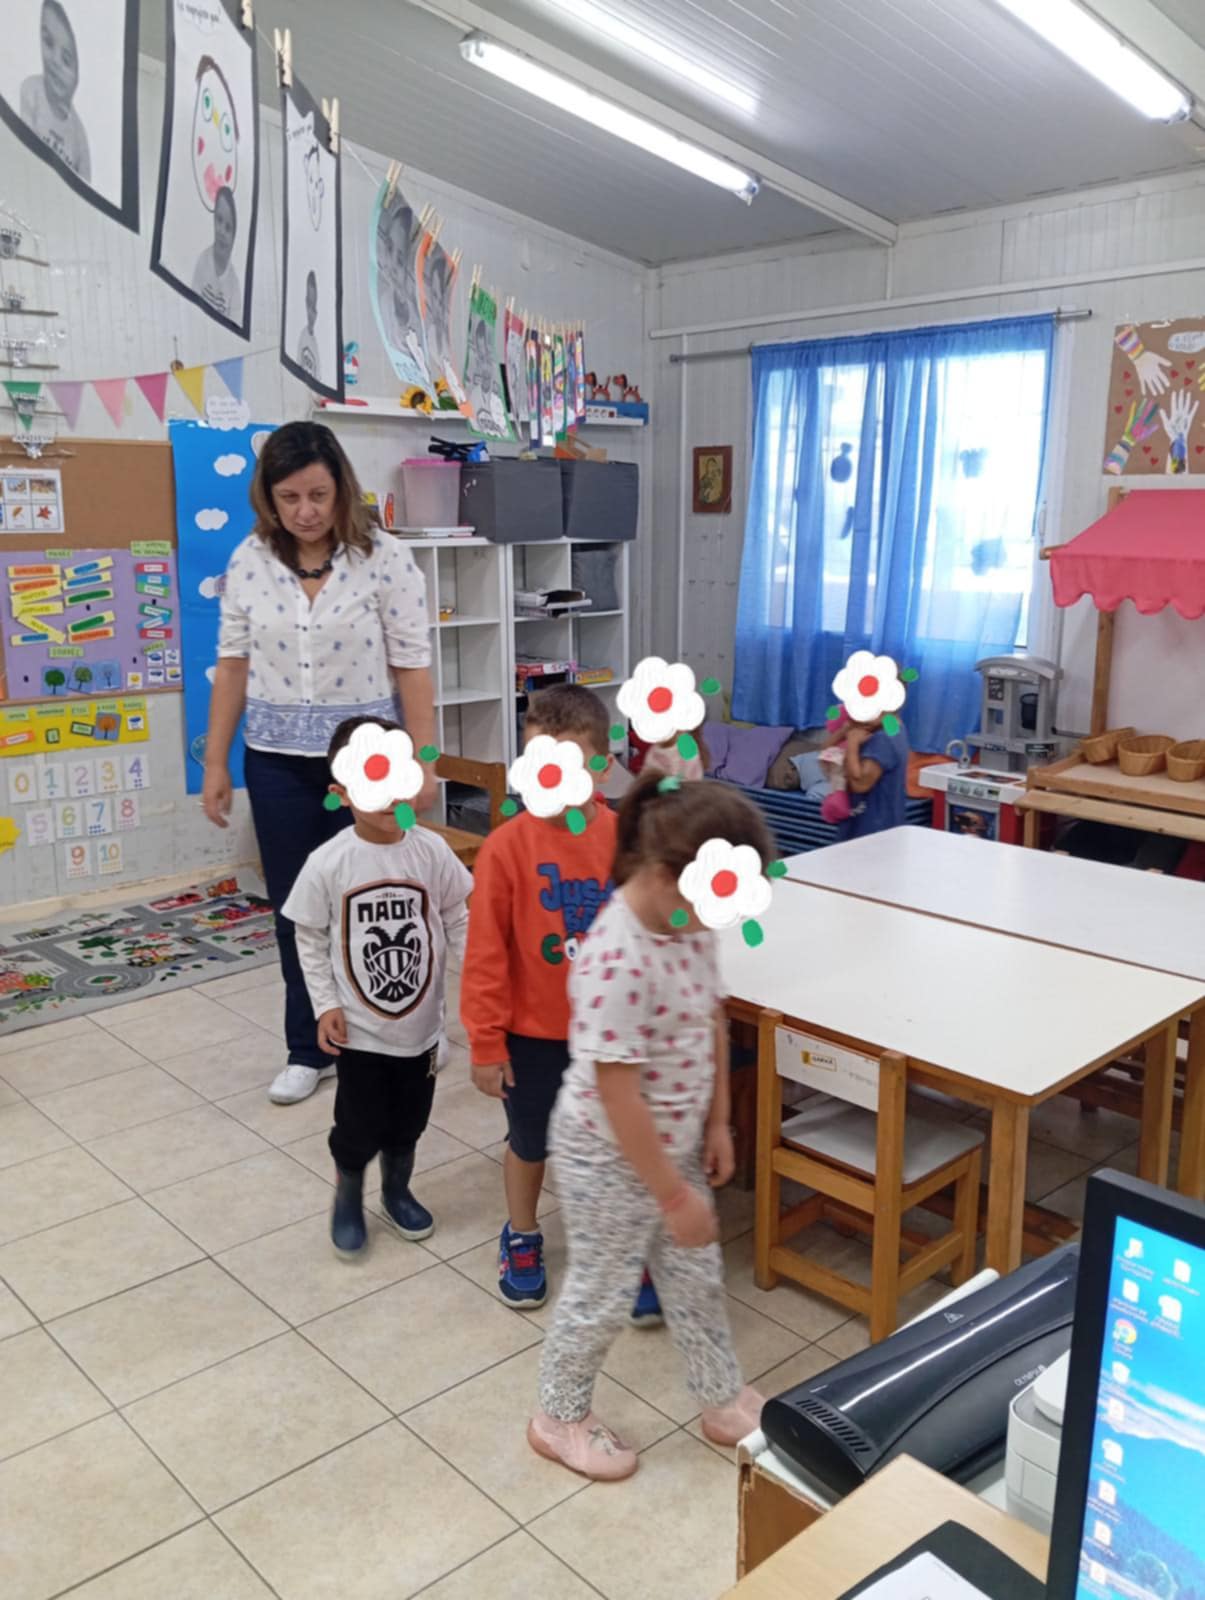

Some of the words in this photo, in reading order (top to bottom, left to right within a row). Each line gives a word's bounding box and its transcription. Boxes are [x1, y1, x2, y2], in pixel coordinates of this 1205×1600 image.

[15, 771, 29, 794] 0
[44, 768, 58, 789] 1
[74, 766, 89, 786] 2
[102, 761, 115, 782] 3
[129, 757, 143, 778] 4
[31, 813, 48, 834] 5
[62, 806, 76, 826] 6
[91, 801, 105, 822] 7
[121, 799, 135, 818] 8
[71, 845, 85, 866] 9
[99, 843, 119, 863] 10
[357, 898, 417, 923] ΠΑΟΚ
